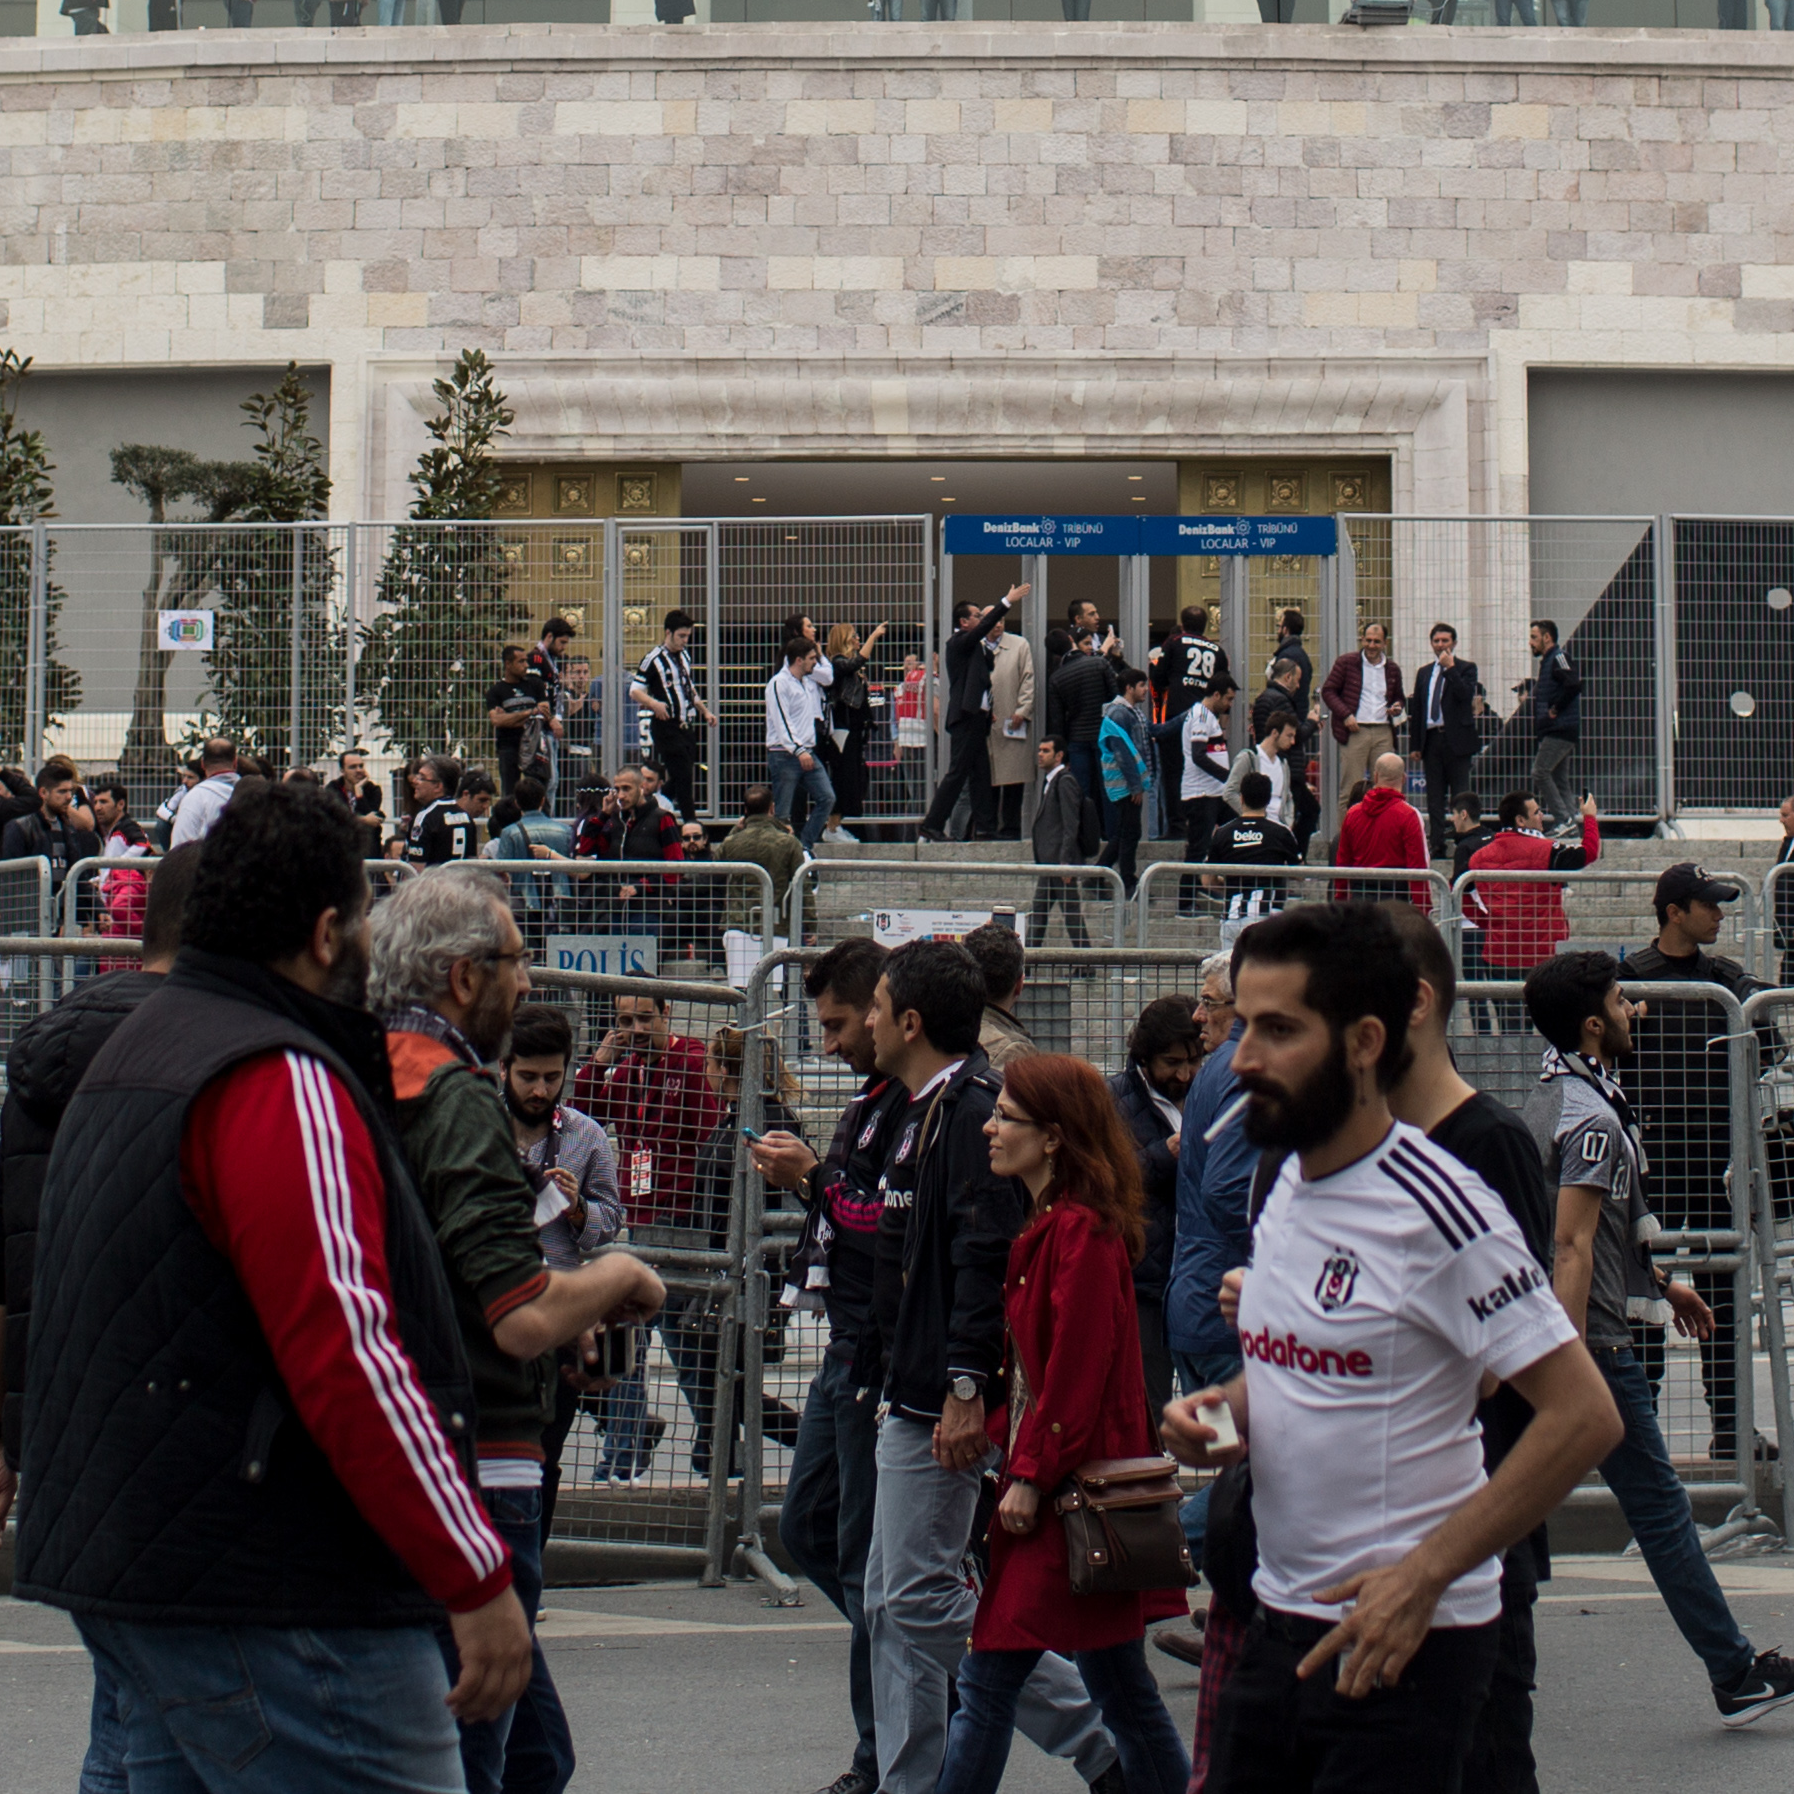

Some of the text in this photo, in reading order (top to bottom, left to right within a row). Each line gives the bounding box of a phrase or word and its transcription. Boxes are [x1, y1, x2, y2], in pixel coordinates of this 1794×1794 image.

[983, 521, 1103, 534] DenizBank TRİBÜNÜ
[1178, 522, 1298, 535] DenizBank TRİBÜNÜ
[1005, 537, 1054, 548] LOCALAR
[1064, 537, 1081, 548] VIP
[1200, 539, 1249, 549] LOCALAR
[1259, 538, 1276, 549] VIP
[1186, 647, 1216, 679] 28
[1233, 830, 1263, 843] beko
[557, 942, 645, 976] POLİS
[1582, 1131, 1609, 1162] 07
[1241, 1326, 1373, 1377] odafone
